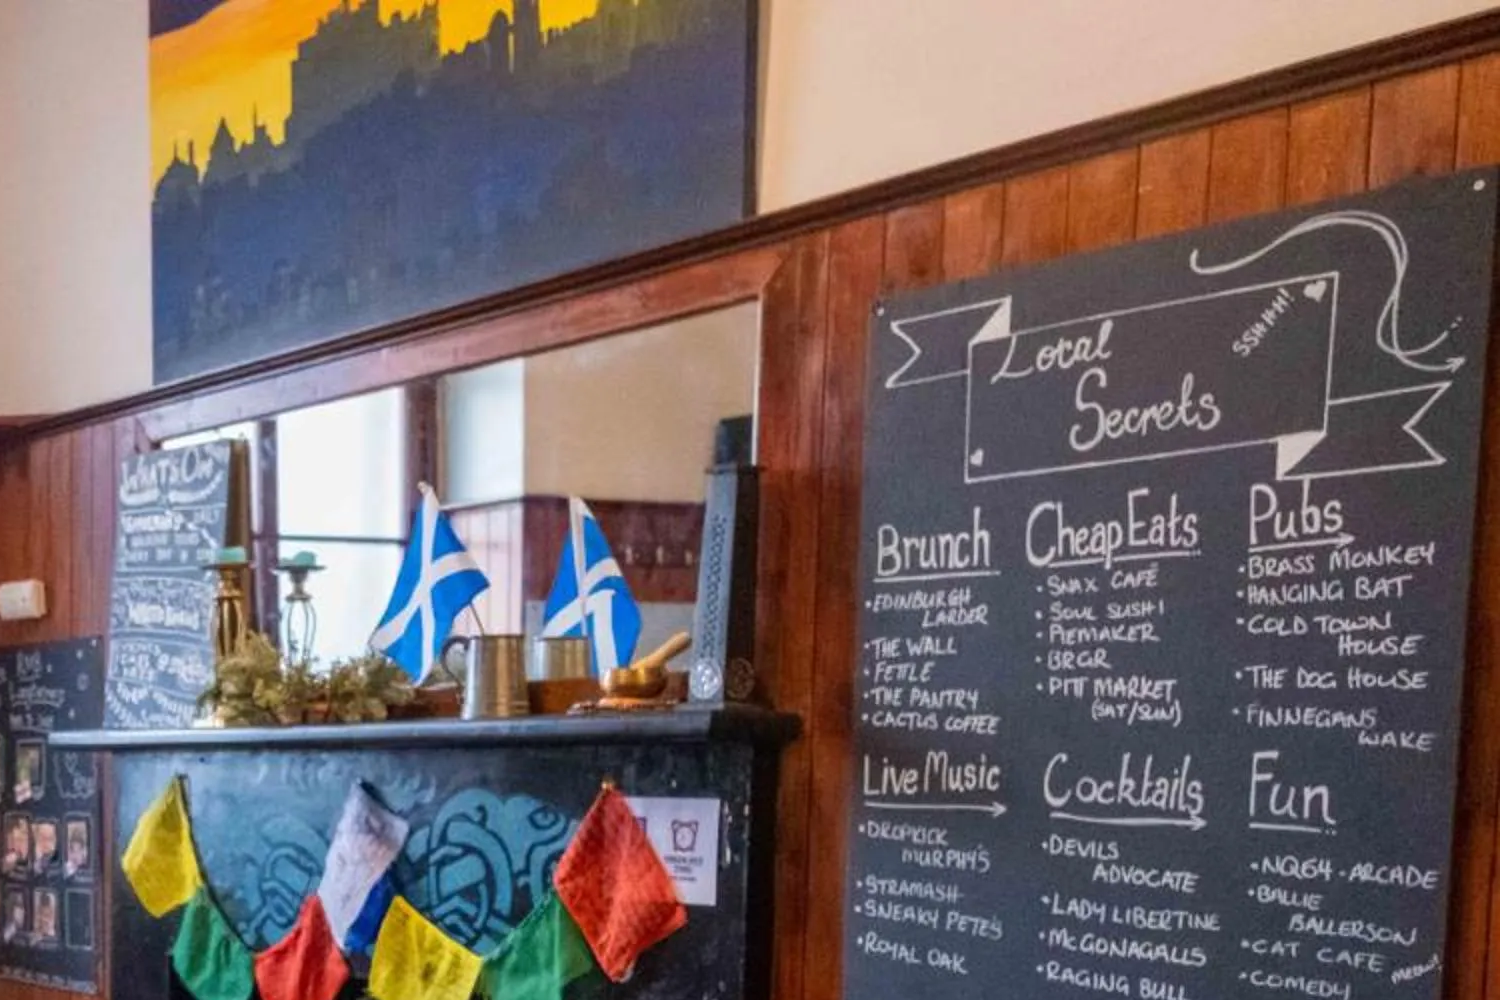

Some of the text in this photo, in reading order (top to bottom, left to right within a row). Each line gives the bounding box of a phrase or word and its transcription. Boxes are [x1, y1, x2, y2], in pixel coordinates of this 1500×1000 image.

[991, 319, 1113, 384] Local
[1070, 368, 1220, 450] Secrets
[1250, 477, 1343, 544] Pubs
[877, 506, 990, 576] Brunch
[1025, 487, 1198, 570] Cheap Eats
[1248, 541, 1435, 579] BRASS MONKEY
[872, 586, 971, 612] EDINBURGH
[1247, 574, 1413, 605] HANGING BAT
[922, 603, 988, 628] LARDER
[1050, 599, 1164, 621] SOUL SUSHI
[1248, 611, 1391, 636] COLD TOWN
[871, 635, 957, 660] THE WALL
[1047, 647, 1112, 670] BRGR
[1338, 634, 1424, 656] HOUSE
[874, 660, 935, 683] FETTLE
[1244, 664, 1429, 689] THE DOG HOUSE
[870, 685, 979, 709] THE PANTRY
[1049, 675, 1177, 702] PITT MARKET
[871, 710, 1000, 734] CACTUS COFFEE
[1247, 703, 1377, 729] FINNEGANS
[1358, 730, 1437, 751] WAKE
[864, 750, 1001, 795] Live Music
[1044, 752, 1204, 815] Cocktails
[1250, 751, 1336, 824] Fun
[867, 820, 948, 846] DROPKICK
[1050, 834, 1119, 860] DEVILS
[1092, 863, 1199, 893] ADVOCATE
[1262, 855, 1440, 889] NQ64 ARCADE
[865, 874, 964, 902] STRAMASH
[1257, 884, 1323, 910] BALLIE
[864, 899, 939, 929] SNEAKY
[1052, 892, 1220, 931] LADY LIBERTINE
[1288, 913, 1417, 945] BALLERSON
[864, 931, 968, 974] ROYAL OAK
[1252, 939, 1385, 973] CAT CAFE
[1046, 960, 1129, 996] RAGING
